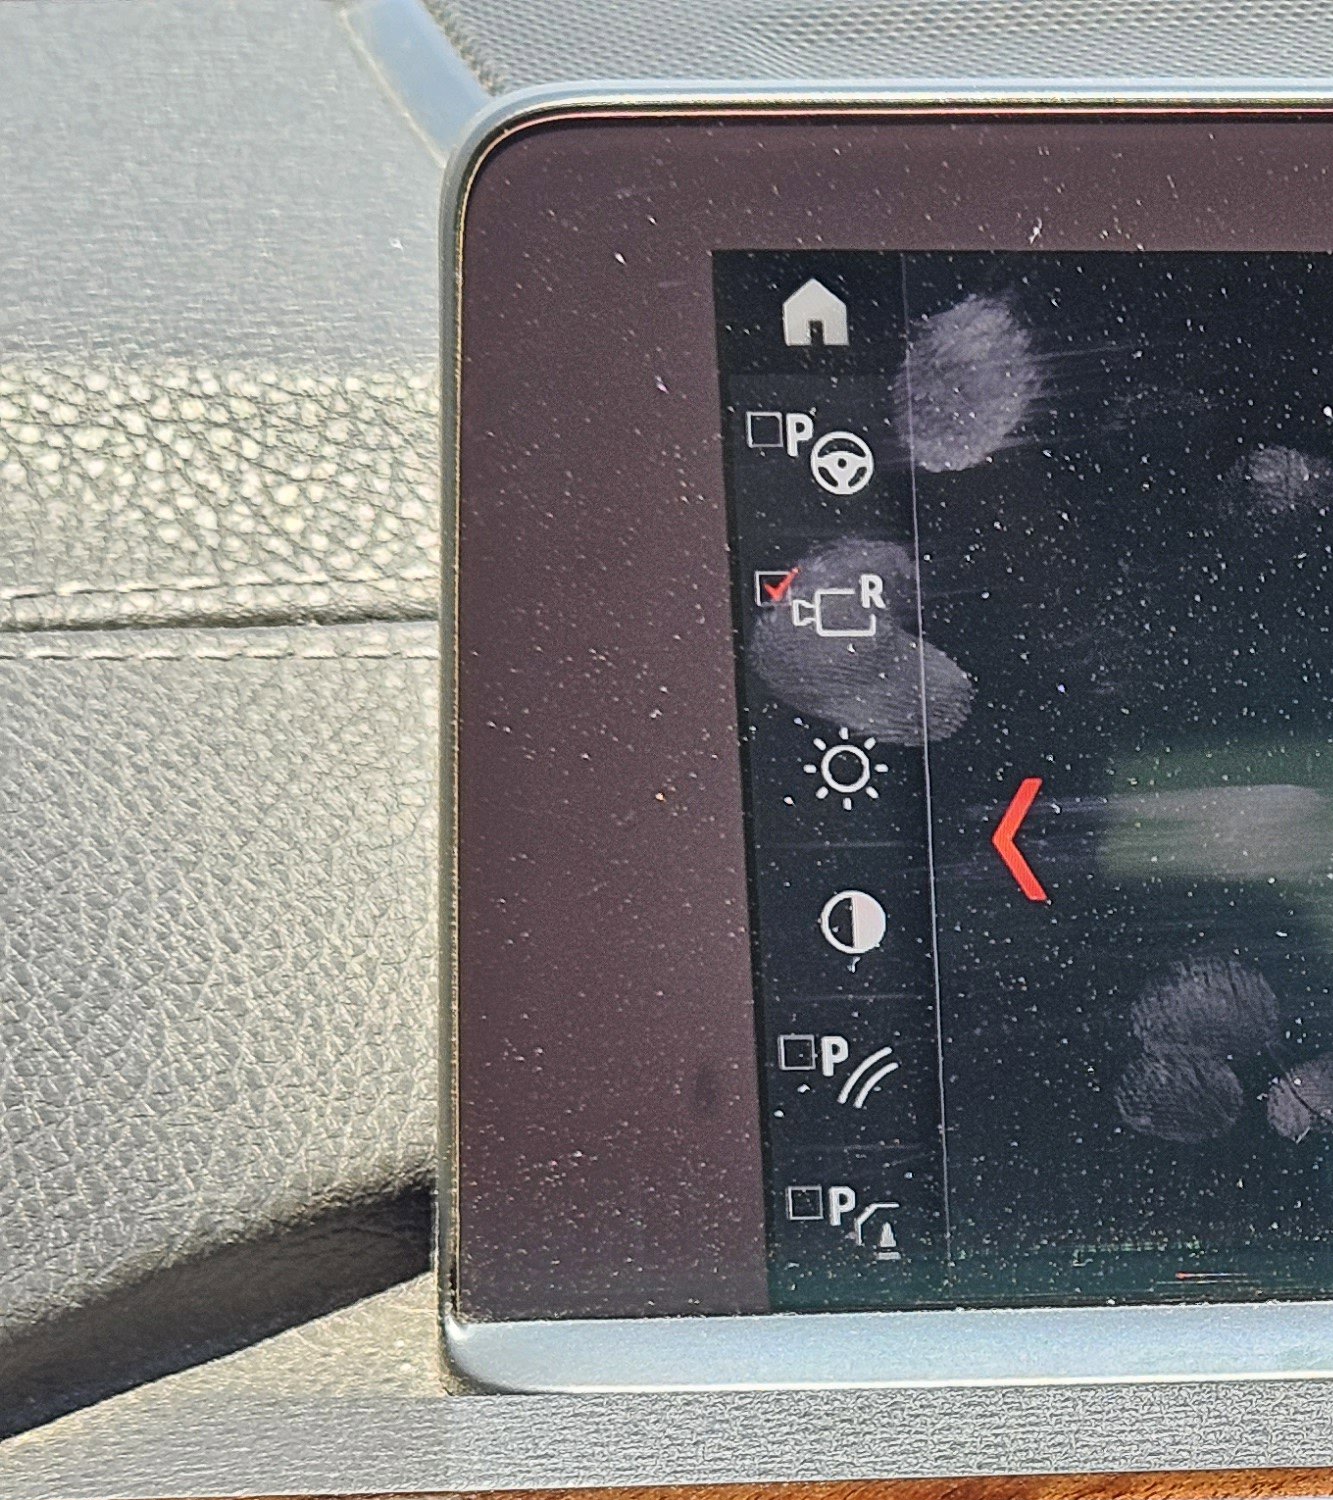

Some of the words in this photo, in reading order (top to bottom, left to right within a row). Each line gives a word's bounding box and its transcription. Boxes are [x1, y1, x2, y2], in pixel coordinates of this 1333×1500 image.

[785, 413, 813, 456] P
[857, 573, 887, 610] R
[820, 1035, 849, 1077] P
[828, 1186, 856, 1227] P
